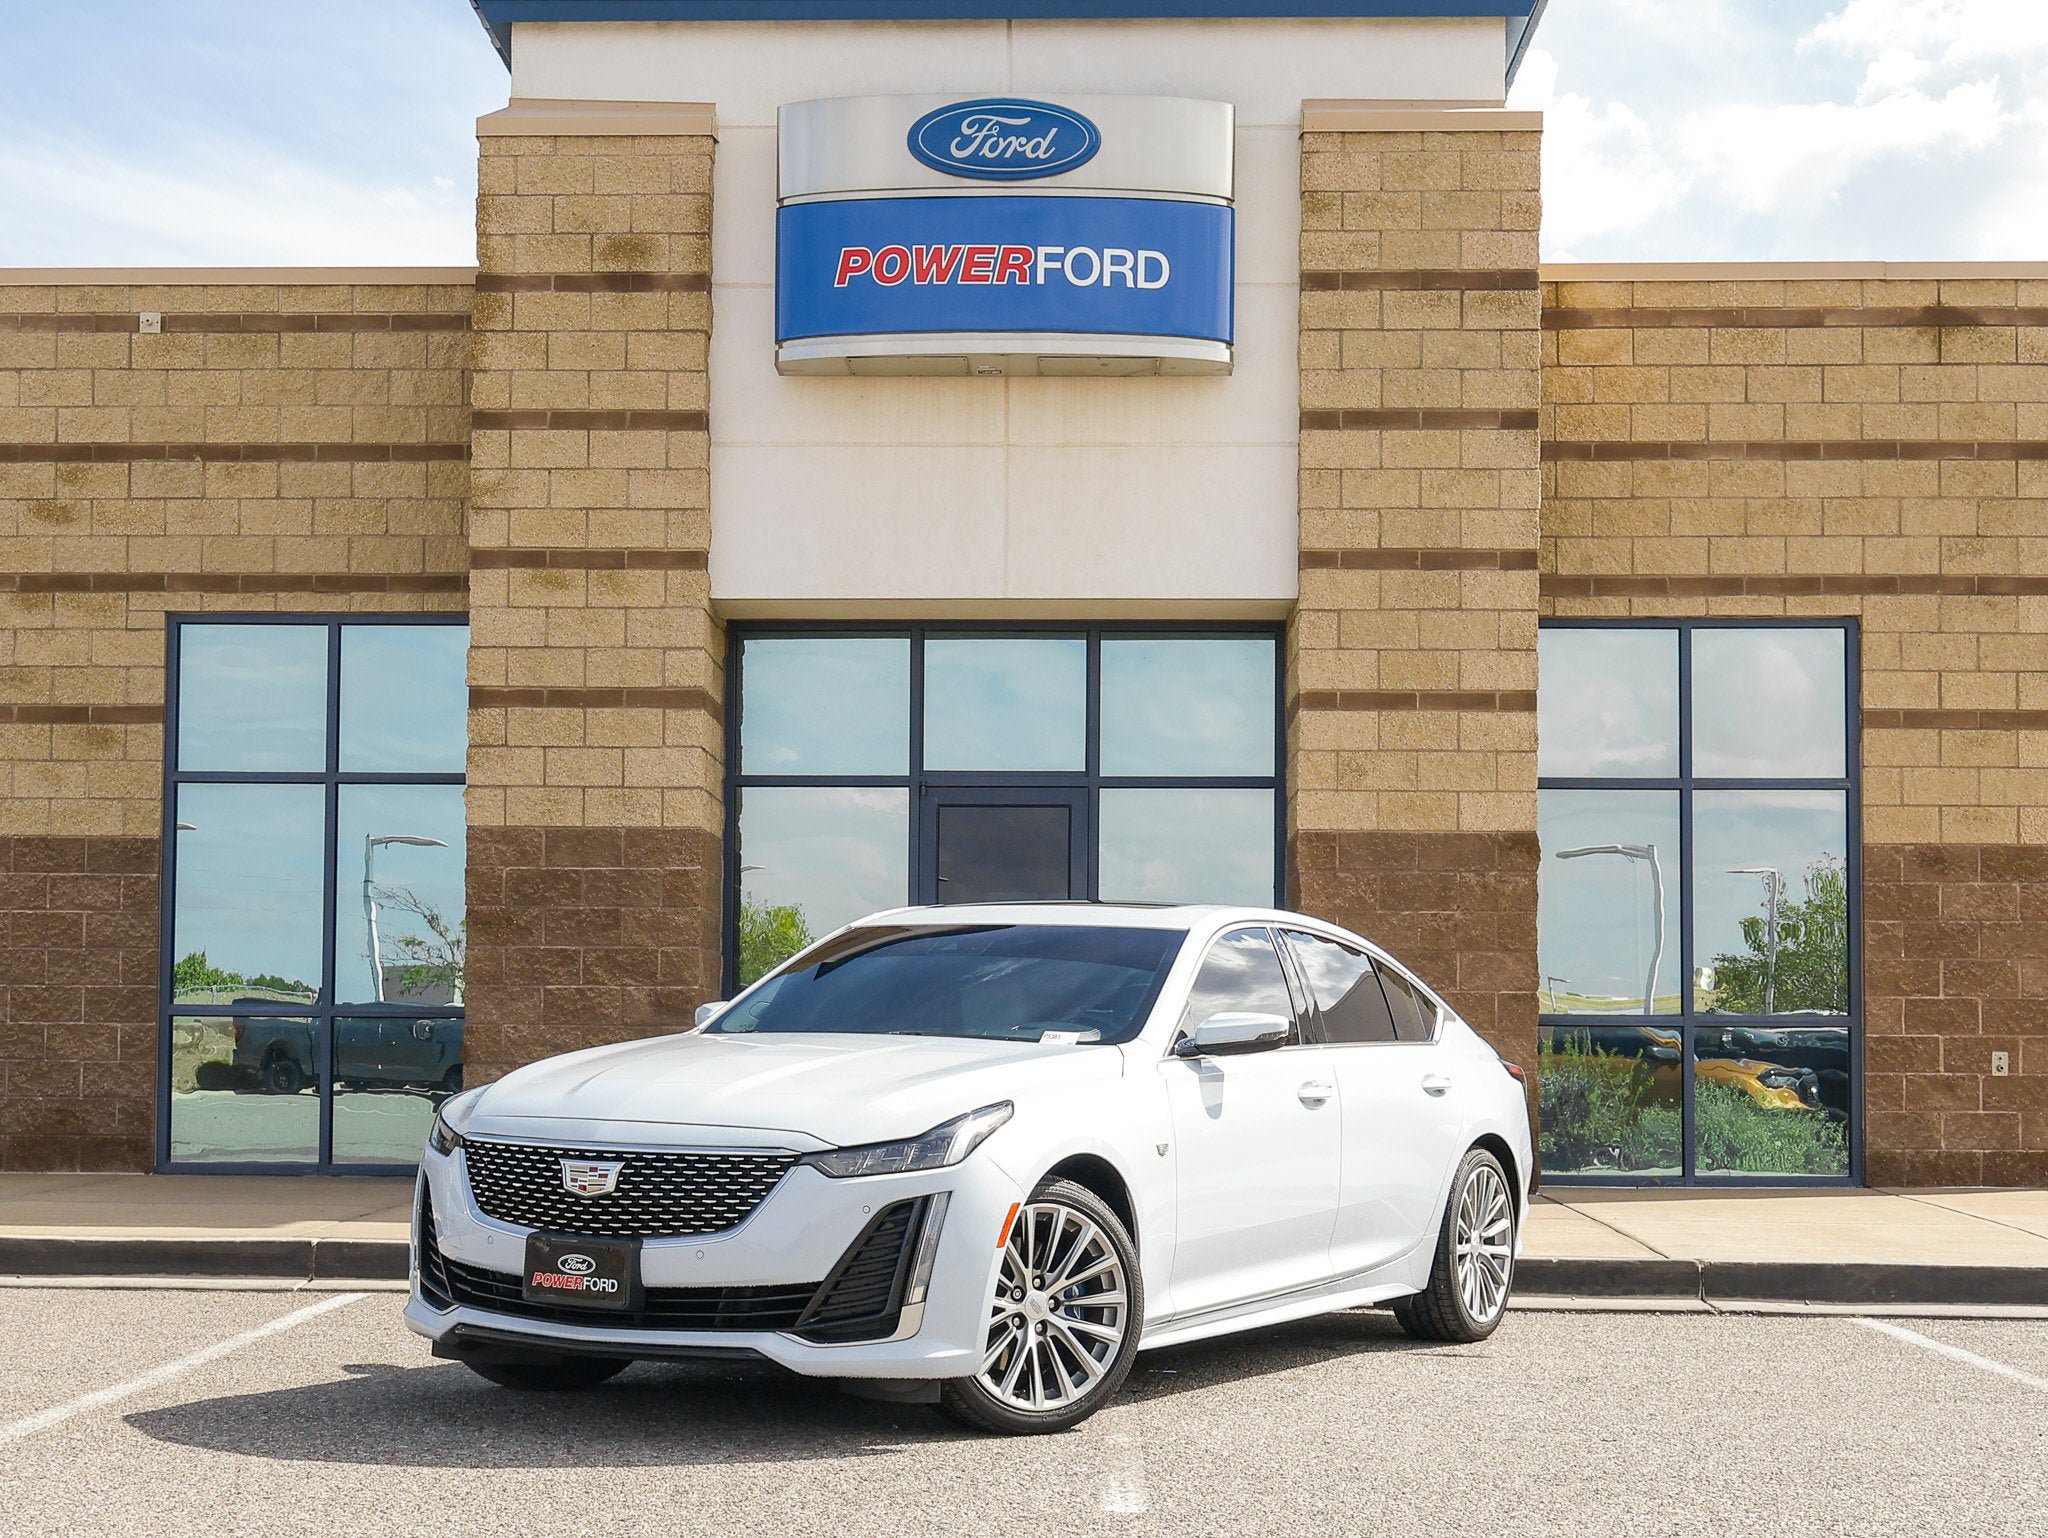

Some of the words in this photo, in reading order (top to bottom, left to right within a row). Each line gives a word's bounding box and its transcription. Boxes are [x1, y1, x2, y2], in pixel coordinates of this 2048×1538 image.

[950, 114, 1058, 159] Ford
[833, 244, 1171, 290] POWERFORD
[564, 1257, 588, 1270] Ford
[531, 1272, 619, 1293] POWERFORD
